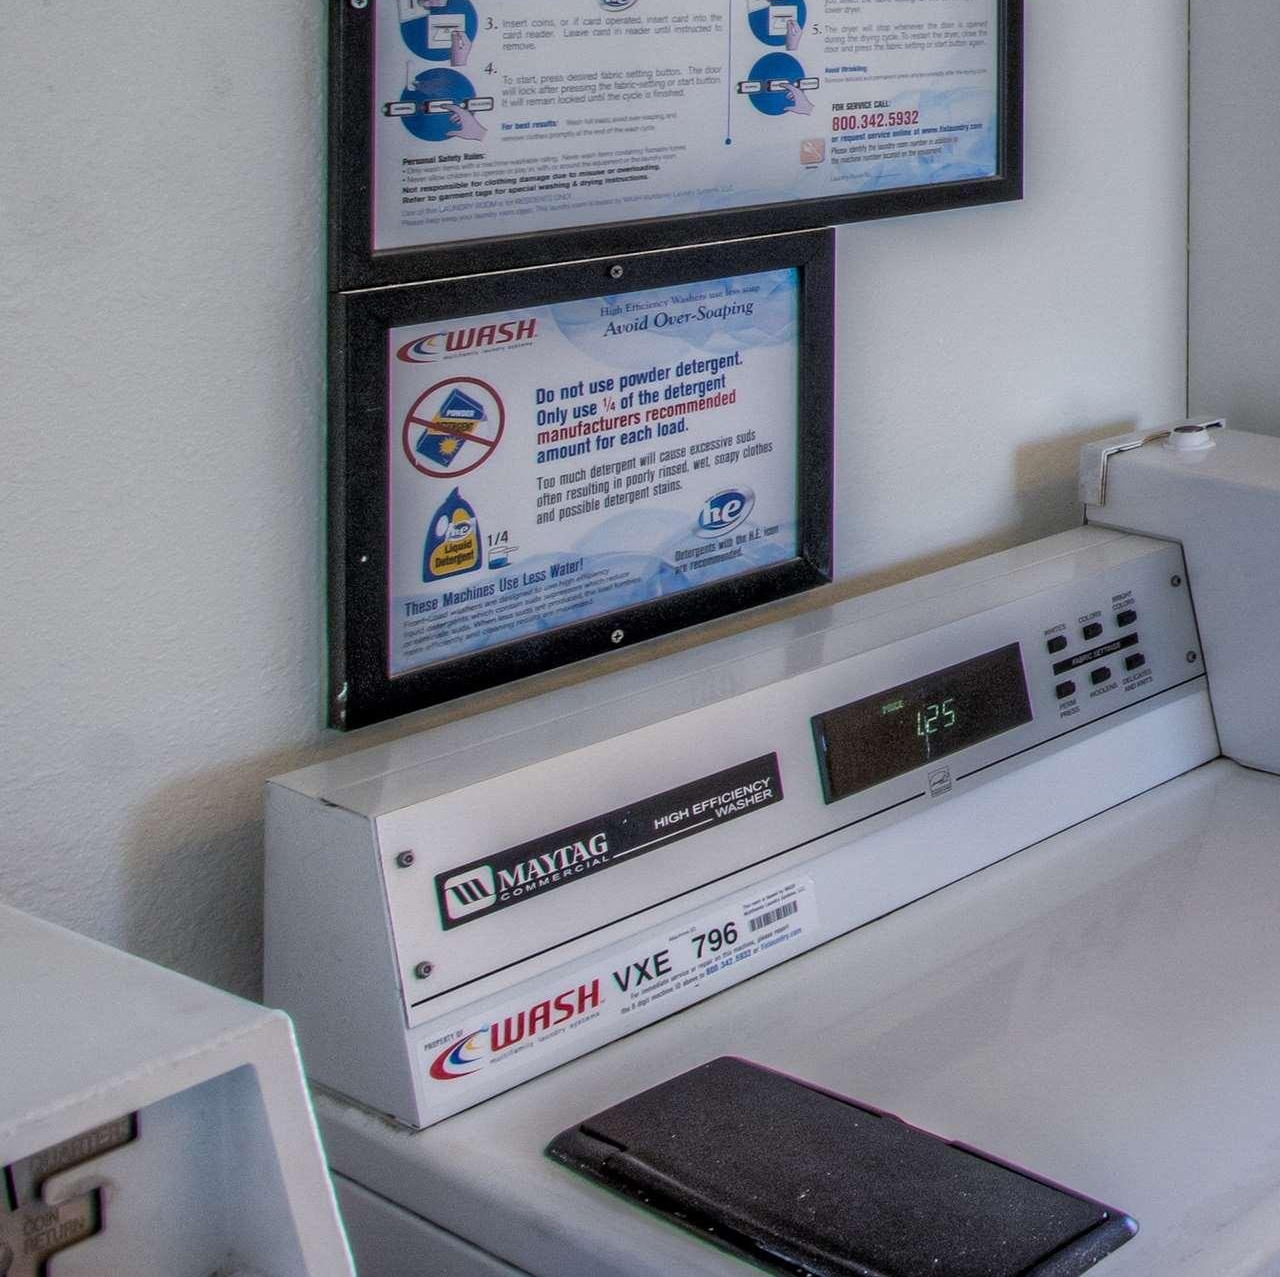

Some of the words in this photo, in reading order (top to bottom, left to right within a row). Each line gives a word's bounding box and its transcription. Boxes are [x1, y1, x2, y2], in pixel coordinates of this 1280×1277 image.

[831, 110, 920, 131] 800.342.5932
[846, 101, 873, 111] SERVICE
[445, 318, 537, 352] WASH
[603, 314, 648, 337] Avoid
[653, 301, 754, 328] Over-Soaping
[536, 387, 555, 405] Do
[560, 380, 584, 400] not
[589, 378, 614, 395] use
[619, 366, 671, 393] powder
[675, 351, 743, 378] detergent.
[536, 406, 568, 426] Only
[572, 403, 598, 419] use
[620, 392, 634, 410] of
[638, 388, 660, 406] the
[664, 374, 726, 401] detergent
[537, 412, 641, 445] manufacturers
[645, 388, 737, 422] recommended
[537, 437, 591, 464] amount
[596, 434, 616, 451] for
[620, 425, 652, 446] each
[657, 416, 689, 438] load.
[536, 476, 556, 491] Too
[559, 467, 587, 486] much
[590, 457, 636, 479] detergent
[639, 451, 656, 467] will
[659, 446, 687, 463] cause
[689, 435, 733, 456] excessive
[736, 428, 756, 445] suds
[536, 491, 563, 508] often
[566, 480, 610, 501] resulting
[613, 476, 623, 490] in
[625, 468, 655, 489] poorly
[714, 450, 740, 466] soapy
[743, 442, 774, 459] clothes
[536, 507, 555, 525] and
[559, 498, 601, 522] possible
[604, 486, 650, 509] detergent
[652, 480, 683, 497] stains.
[435, 550, 474, 568] Detergent
[444, 539, 472, 554] Liquid
[487, 530, 509, 547] 1/4
[674, 543, 716, 562] Detergents
[404, 598, 438, 617] These
[442, 584, 495, 608] Machines
[499, 576, 519, 593] Use
[523, 569, 547, 586] Less
[550, 557, 584, 579] Water!
[653, 807, 690, 830] HIGH
[692, 777, 771, 816] EFFICIENCY
[714, 788, 774, 818] WASHER
[497, 832, 609, 893] MAYTAG
[500, 855, 610, 901] COMMERCIAL
[611, 948, 673, 993] VXE
[691, 921, 739, 959] 796
[490, 978, 600, 1053] WASH
